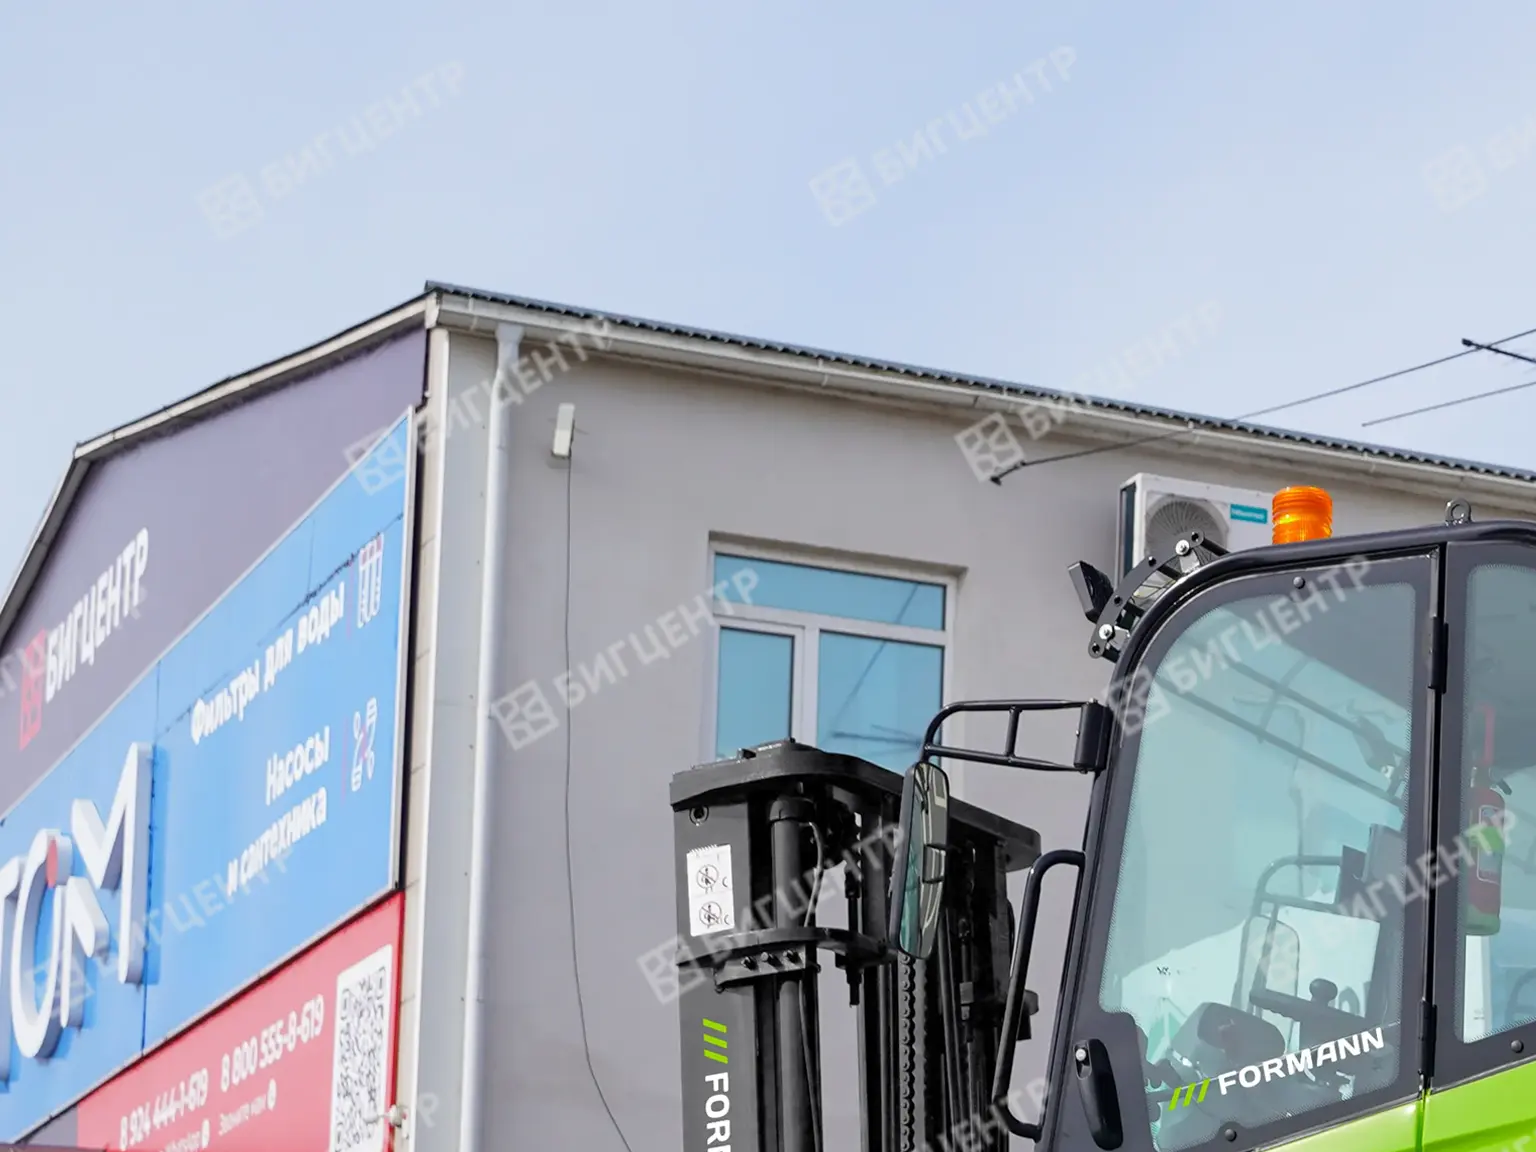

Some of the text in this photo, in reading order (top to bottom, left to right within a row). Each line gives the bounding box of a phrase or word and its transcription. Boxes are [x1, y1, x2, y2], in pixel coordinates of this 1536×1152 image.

[46, 527, 149, 704] БИГЦЕНТР
[191, 582, 345, 745] Фильтры для воды
[266, 726, 330, 806] Насосы
[240, 787, 328, 889] сантехника
[220, 1053, 230, 1093] 8
[232, 1035, 258, 1086] 800
[1218, 1027, 1385, 1096] FORMANN
